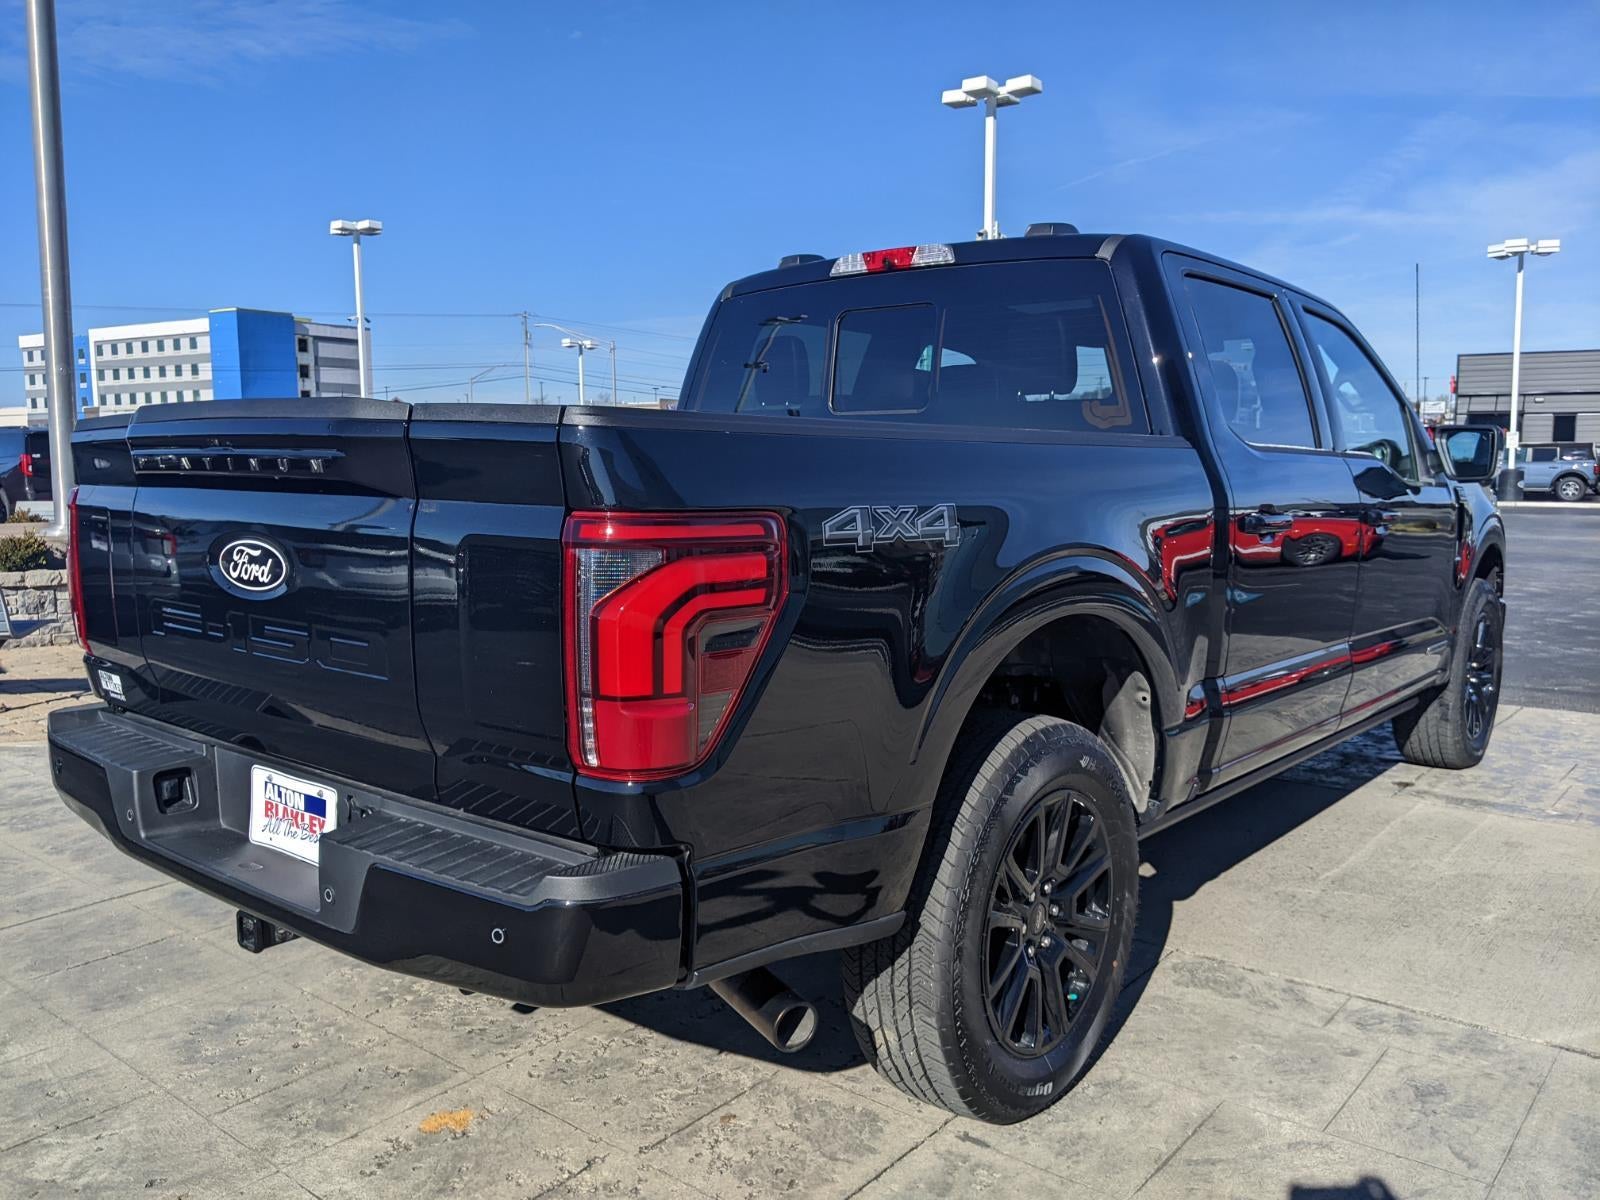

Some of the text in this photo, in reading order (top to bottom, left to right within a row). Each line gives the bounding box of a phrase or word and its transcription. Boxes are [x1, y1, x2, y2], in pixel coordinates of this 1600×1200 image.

[229, 545, 272, 583] Ford
[264, 781, 305, 813] ALTON
[300, 822, 320, 844] Bes
